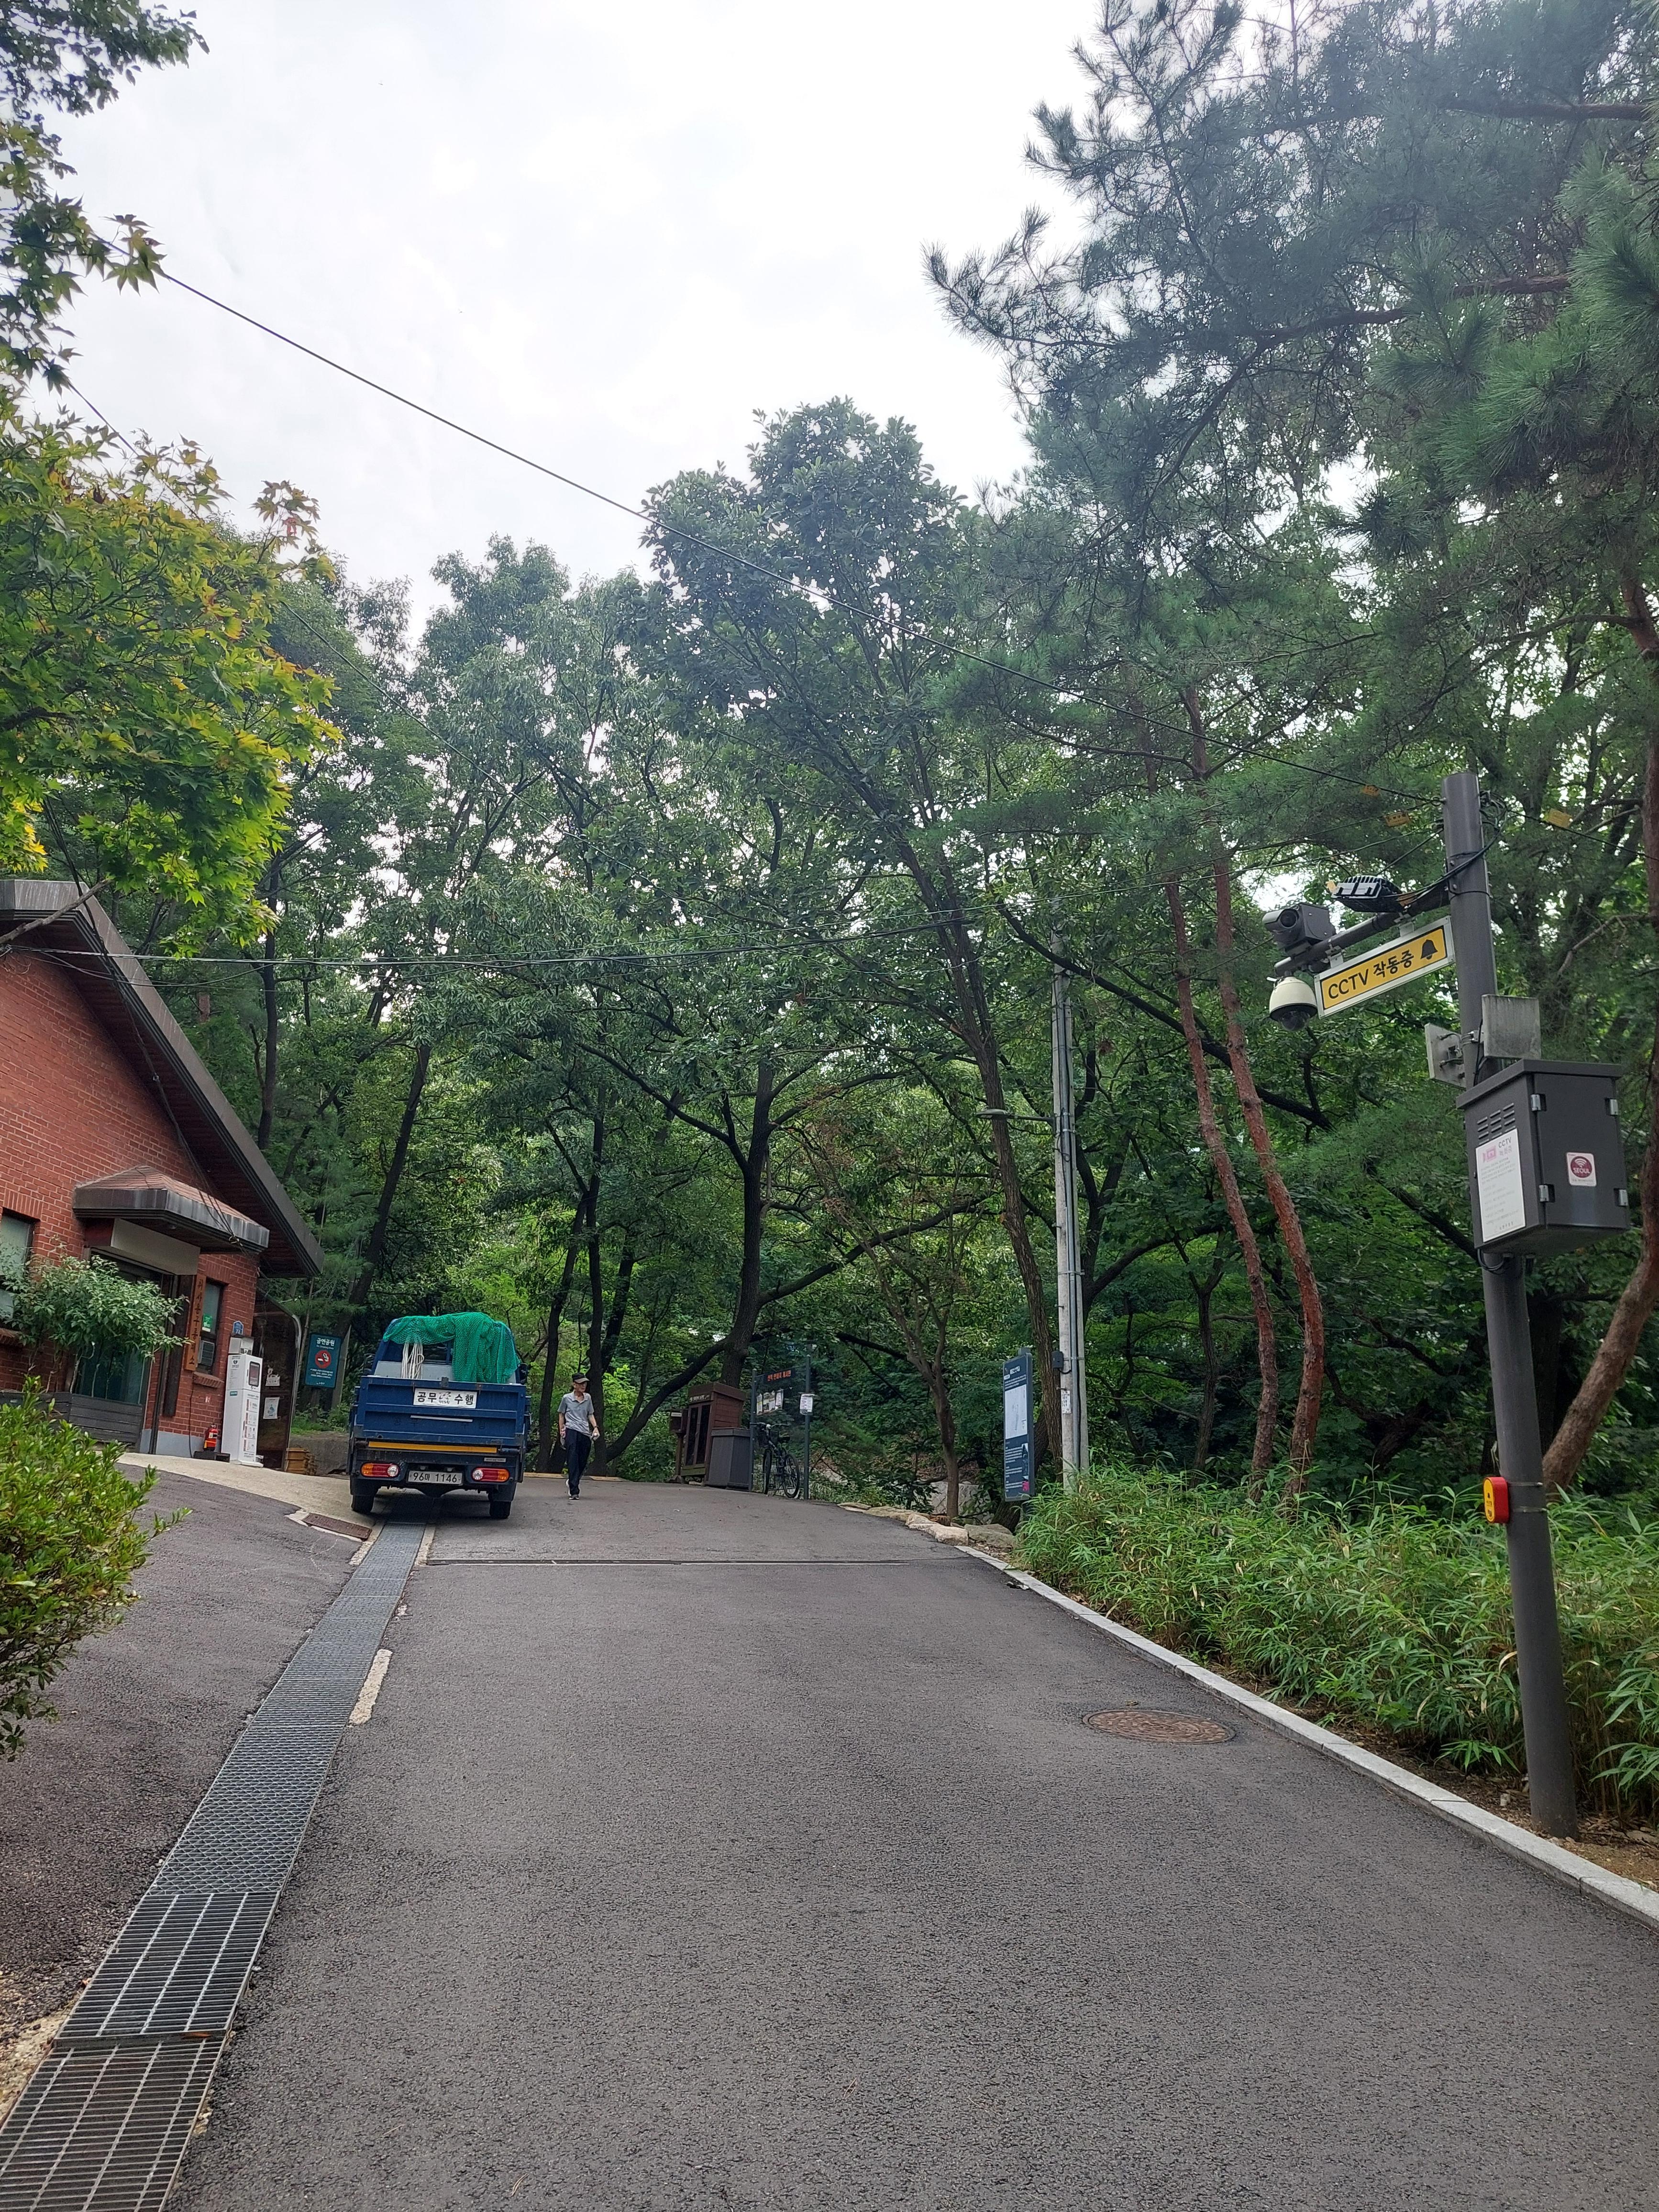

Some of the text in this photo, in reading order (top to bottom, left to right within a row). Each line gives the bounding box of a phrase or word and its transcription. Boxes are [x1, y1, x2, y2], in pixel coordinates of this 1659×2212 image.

[1328, 949, 1415, 999] CCTV 작동중
[1498, 1136, 1512, 1148] CCTV
[317, 1338, 335, 1347] 금연공원
[417, 1391, 474, 1405] 공무 수행
[413, 1472, 457, 1482] 96마 1146
